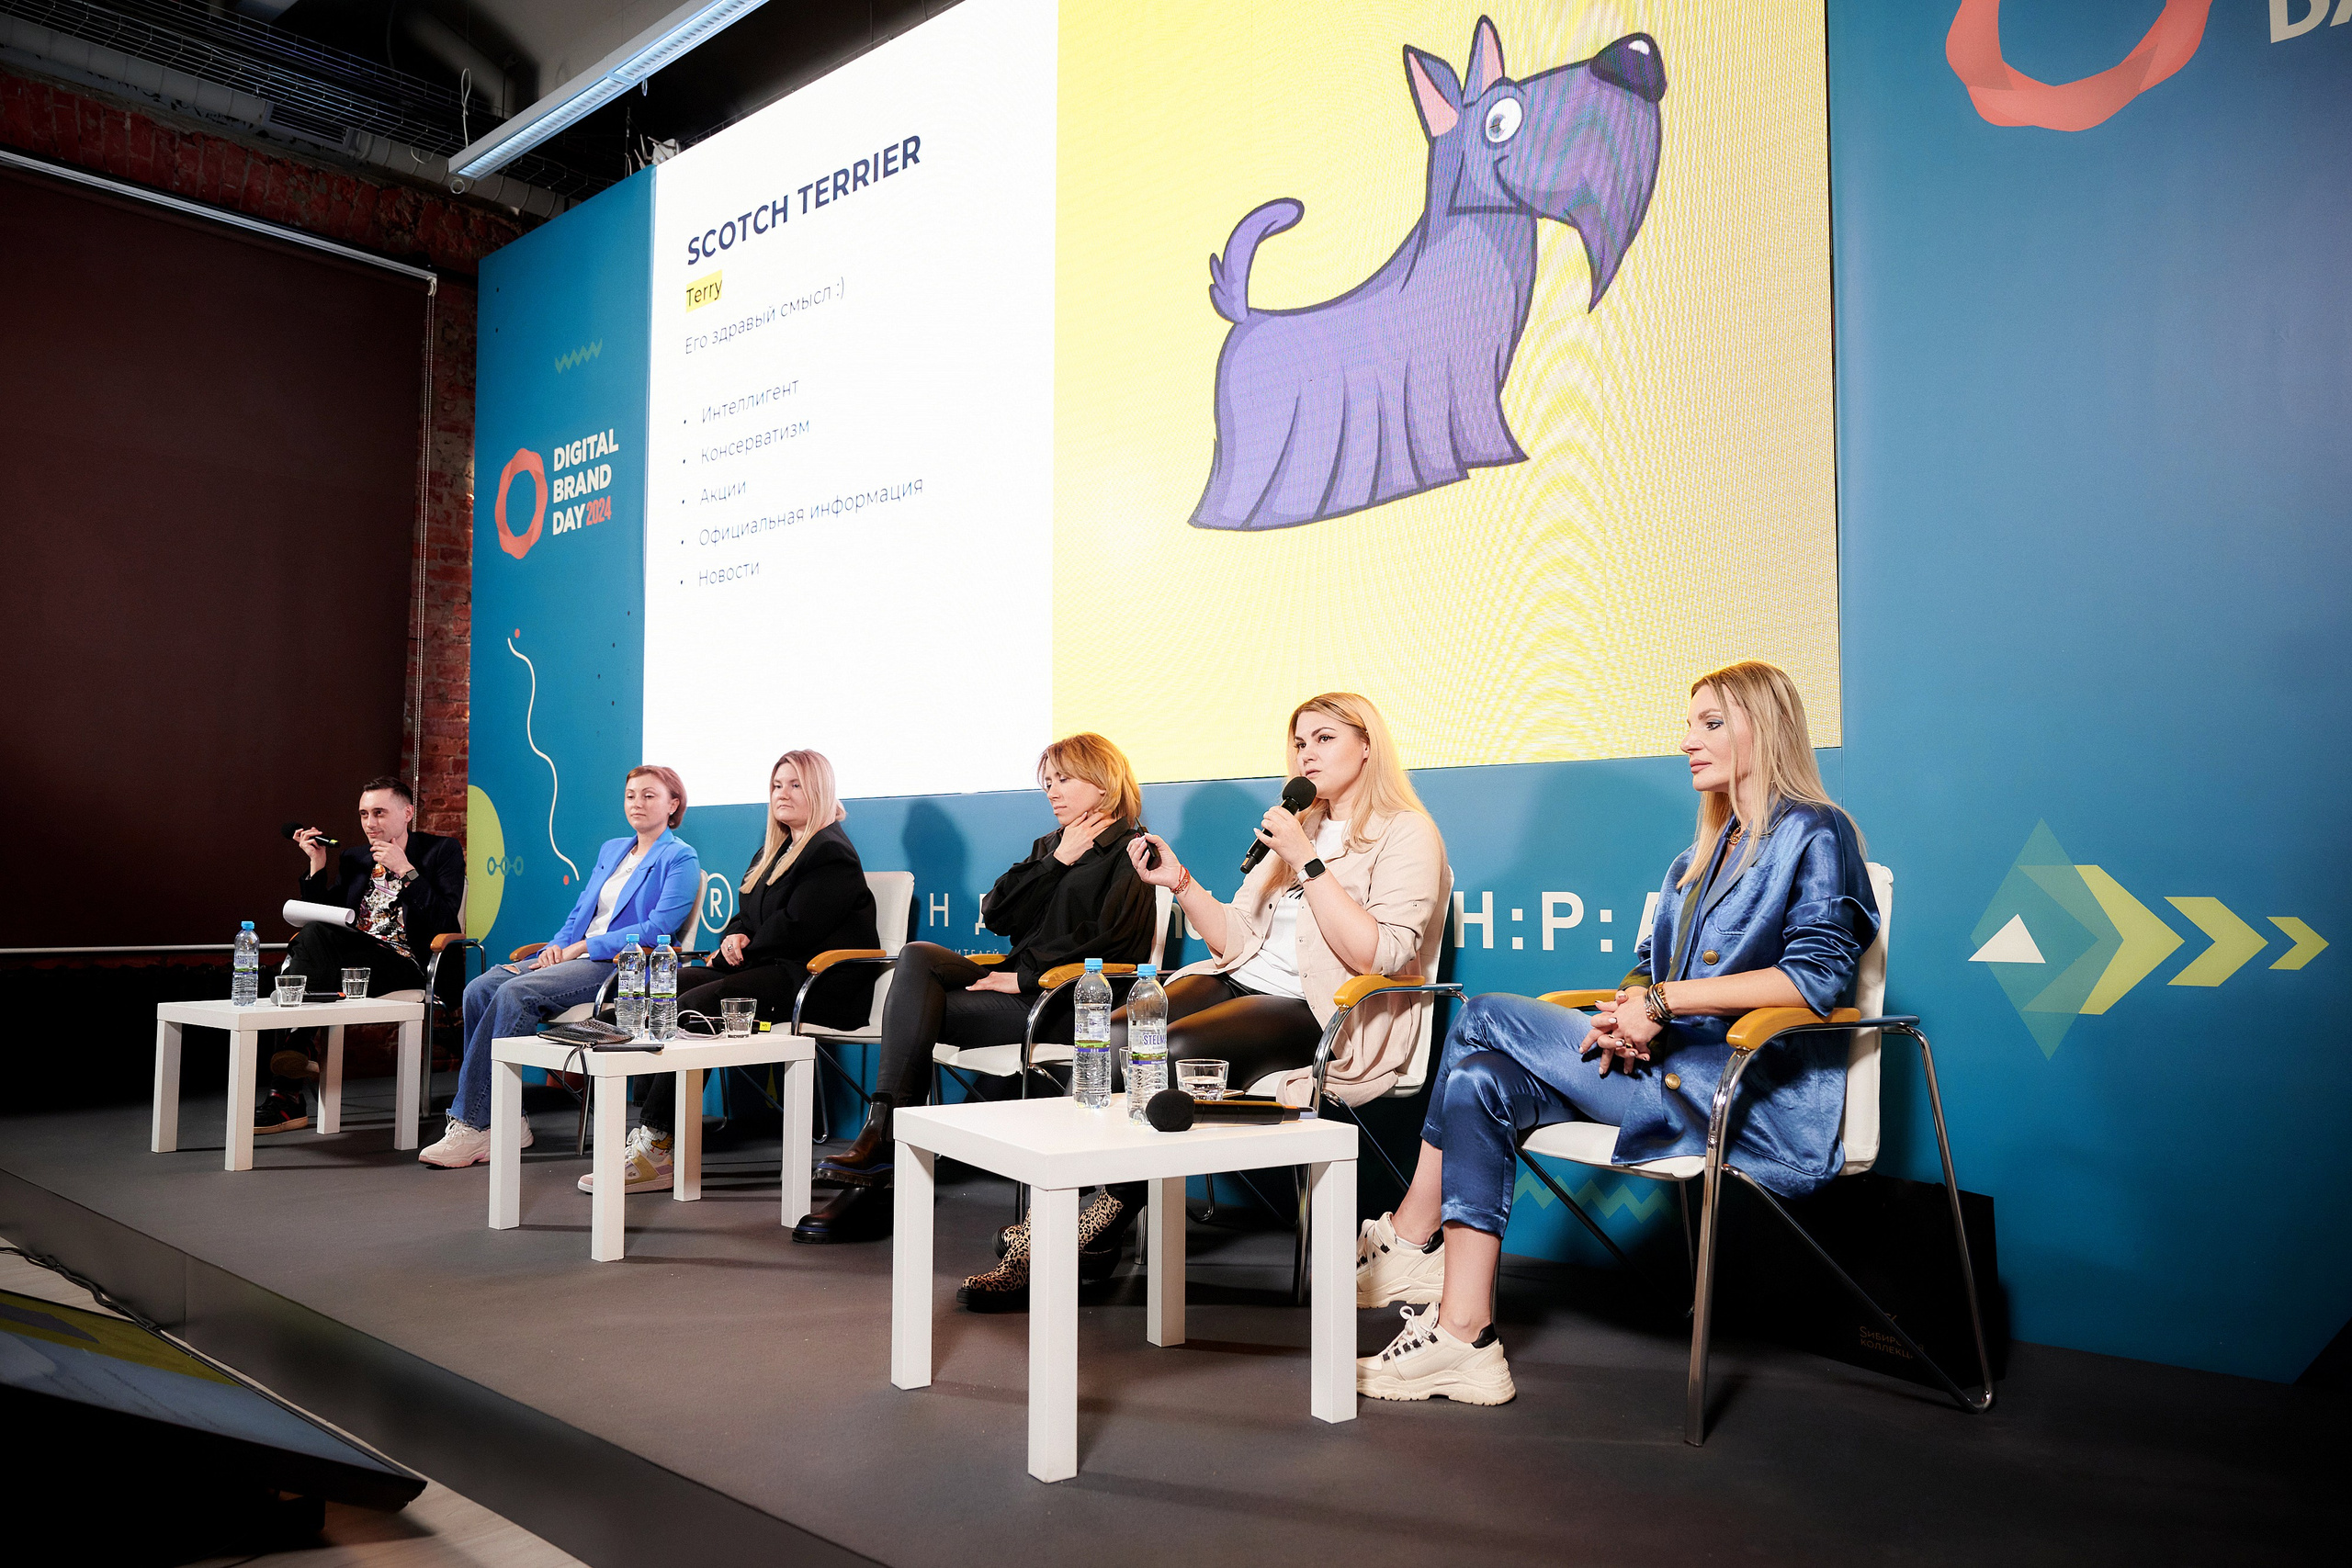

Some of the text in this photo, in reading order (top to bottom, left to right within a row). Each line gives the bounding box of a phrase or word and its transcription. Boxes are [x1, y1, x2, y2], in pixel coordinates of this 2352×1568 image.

[687, 135, 922, 266] SCOTCH TERRIER
[685, 279, 723, 307] Terry
[685, 332, 708, 355] Его
[712, 306, 776, 346] здравый
[780, 286, 831, 318] смысл
[702, 379, 799, 424] Интеллигент
[553, 428, 619, 472] DIGITAL
[701, 419, 810, 465] Консерватизм
[553, 463, 613, 503] BRAND
[699, 480, 747, 506] Акции
[552, 495, 613, 536] DAY 2024
[698, 478, 923, 547] Официальная информация
[698, 561, 760, 587] Новости
[1143, 1033, 1167, 1045] STELM
